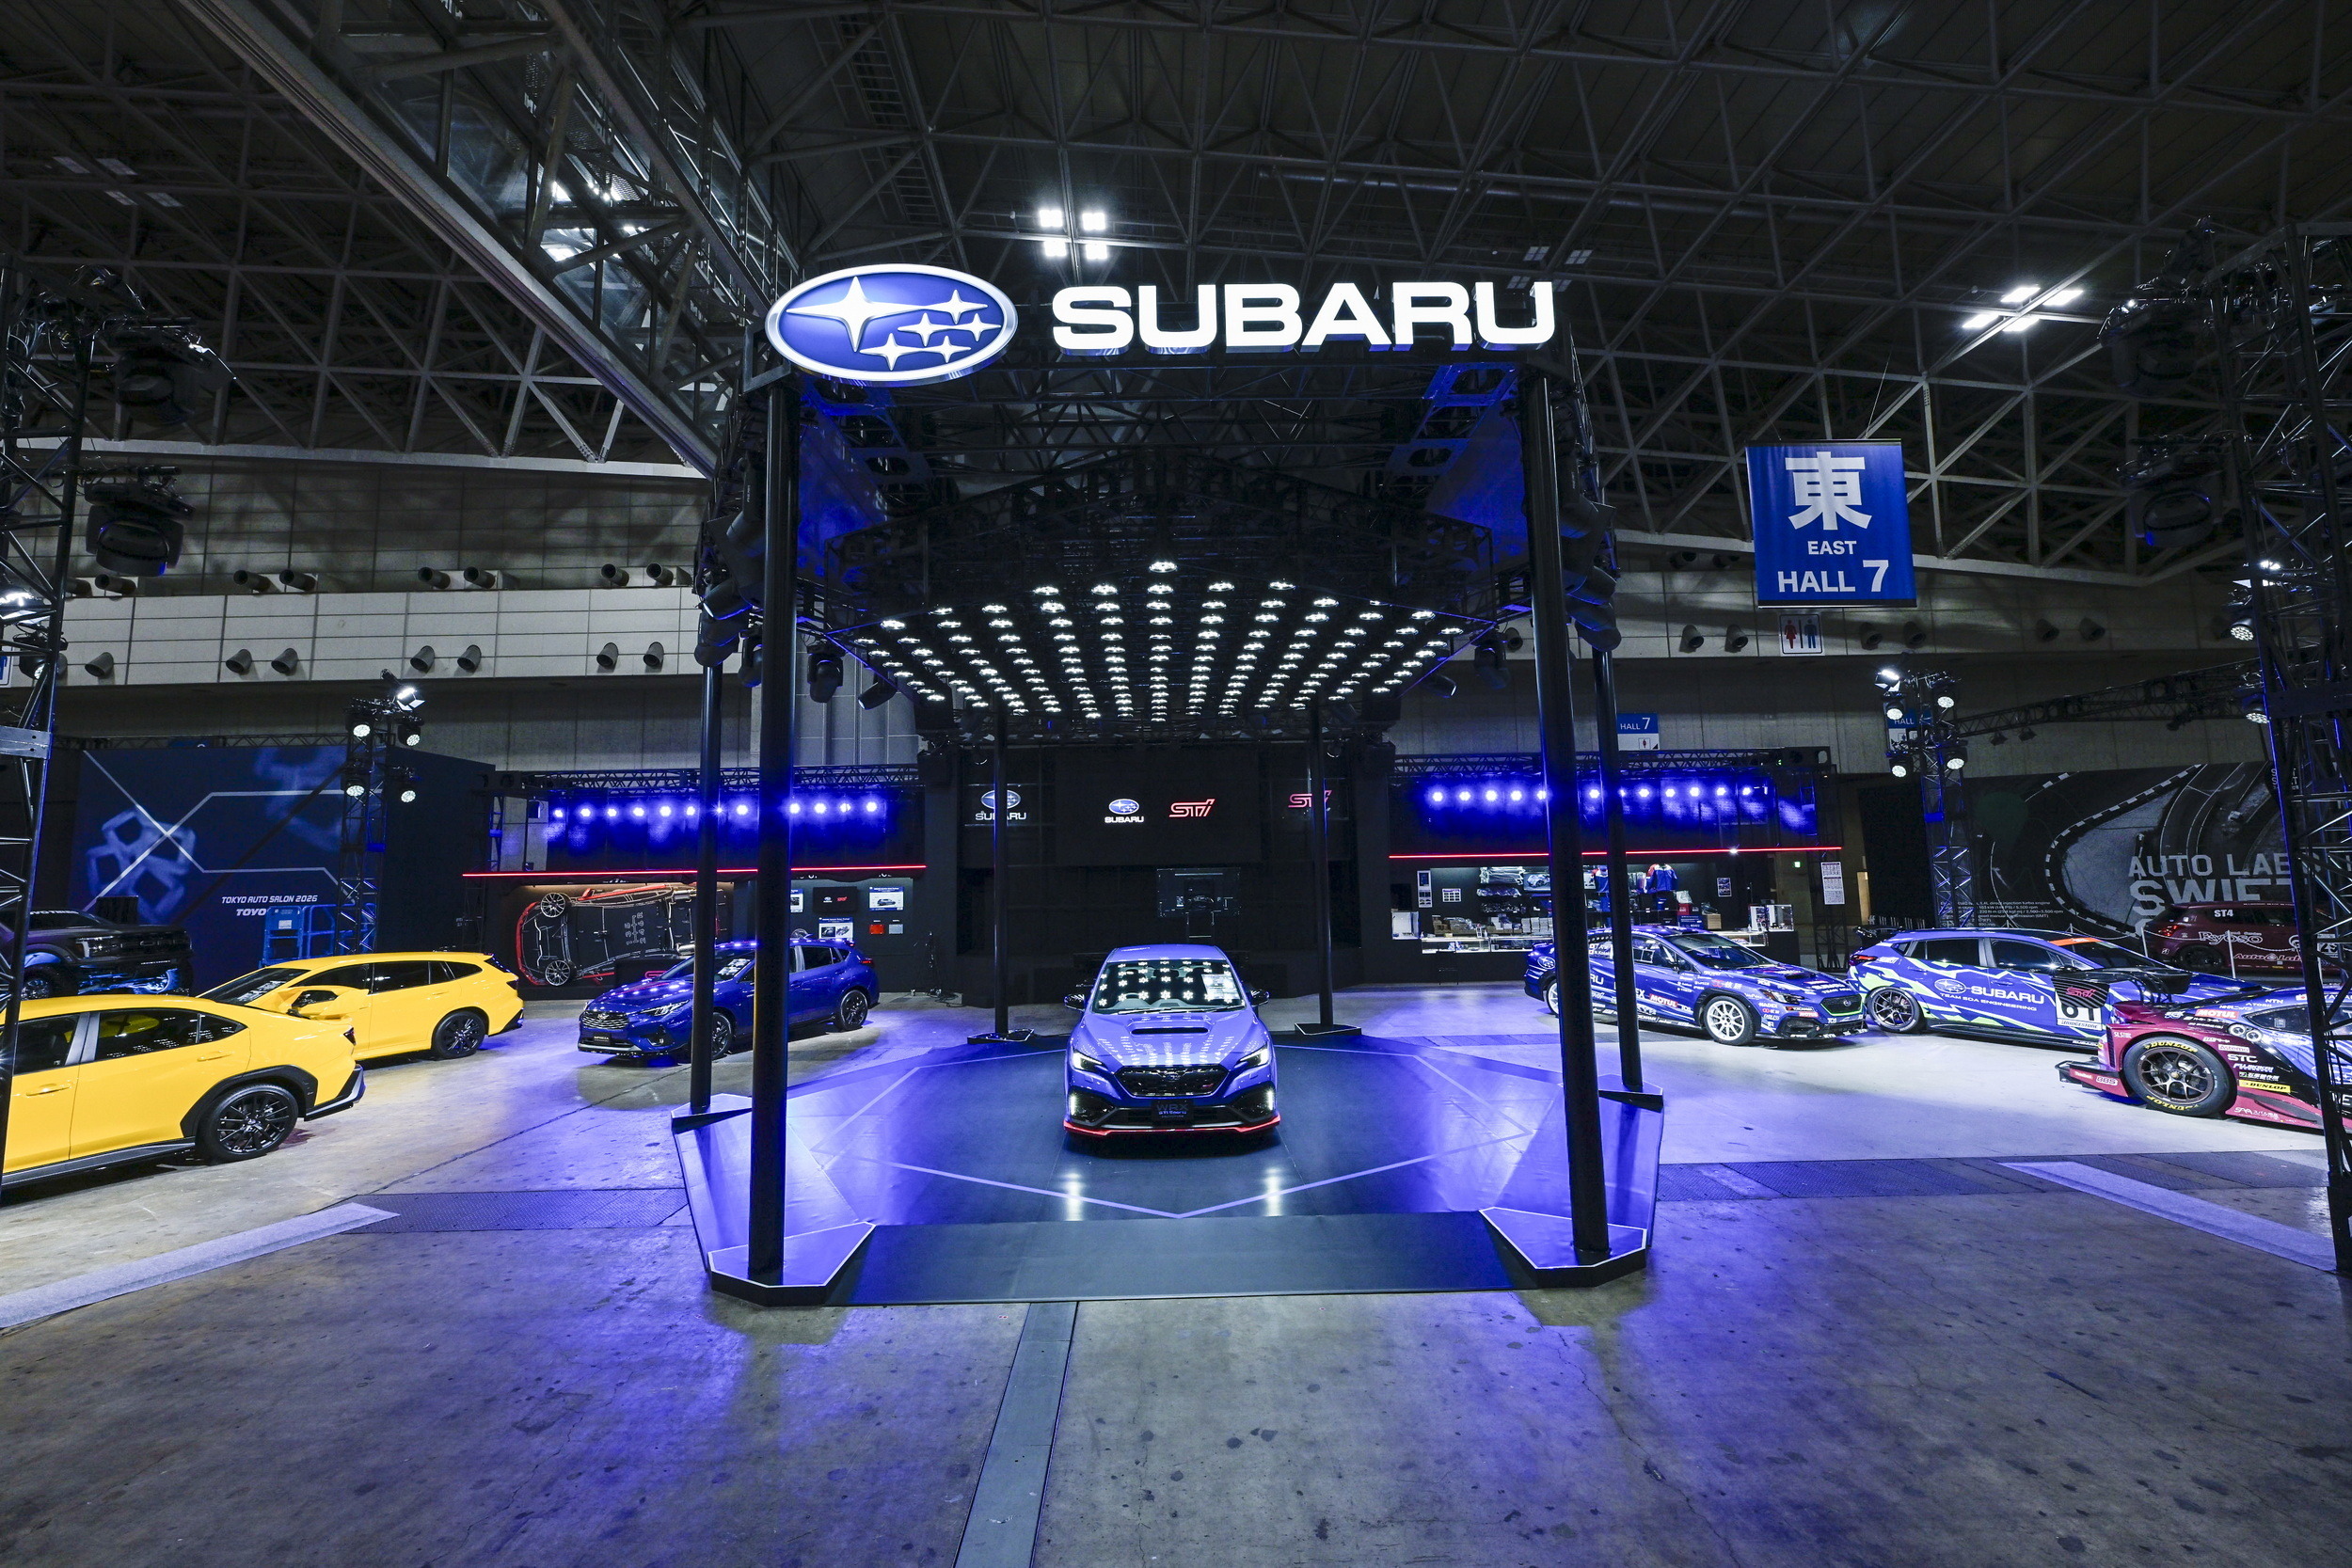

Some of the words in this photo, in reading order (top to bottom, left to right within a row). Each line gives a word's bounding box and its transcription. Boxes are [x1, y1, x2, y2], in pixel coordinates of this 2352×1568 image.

[1052, 281, 1555, 352] SUBARU
[1785, 451, 1872, 530] 東
[1807, 540, 1857, 555] EAST
[1777, 571, 1855, 593] HALL
[1863, 560, 1889, 592] 7
[1642, 717, 1650, 730] 7
[975, 812, 1026, 820] SURU
[2128, 854, 2213, 877] AUTO
[236, 908, 266, 916] TOYO
[2214, 909, 2234, 917] ST4
[1650, 994, 1677, 1007] MOTUL
[1971, 985, 2045, 1005] SUBARU
[1980, 999, 2038, 1011] ENGINEERING
[2196, 1009, 2236, 1019] MOTUL
[2061, 1020, 2099, 1029] BRIDGESTONE
[2150, 1041, 2198, 1053] DUNLOP
[2227, 1053, 2258, 1063] STC
[2096, 1076, 2118, 1085] BBS
[2249, 1082, 2287, 1090] DUNLOP
